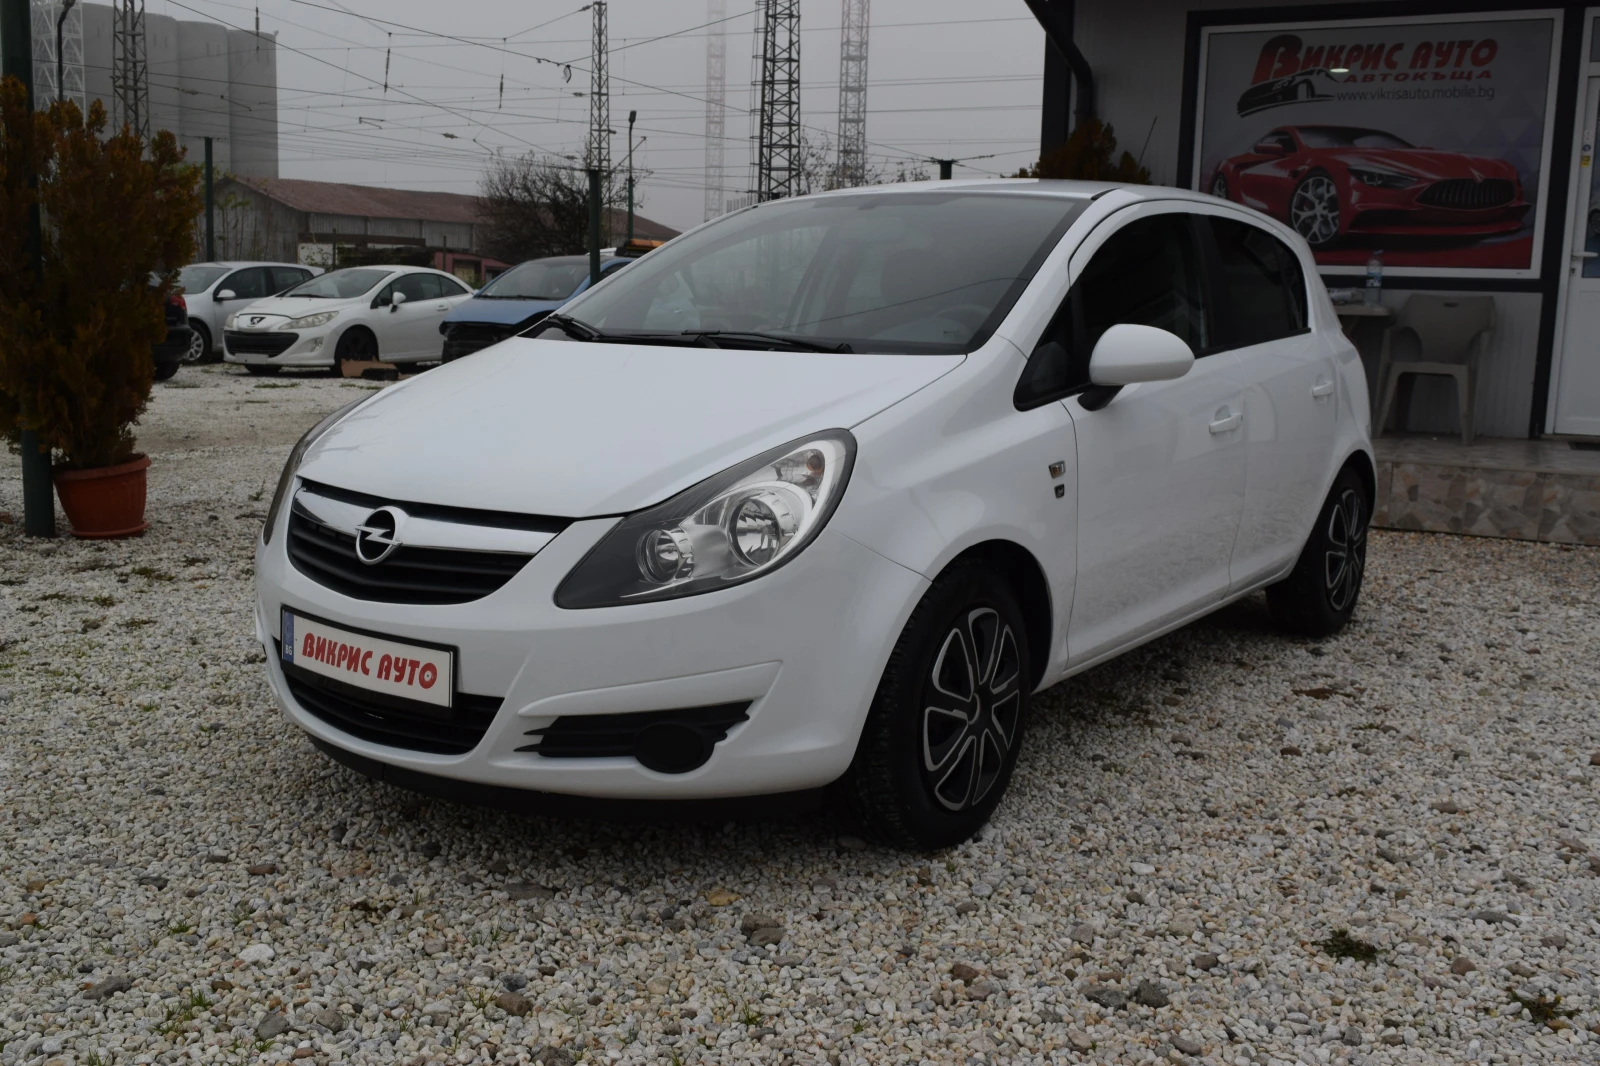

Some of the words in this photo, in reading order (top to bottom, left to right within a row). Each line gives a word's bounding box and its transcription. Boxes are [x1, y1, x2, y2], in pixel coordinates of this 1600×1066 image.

[1409, 39, 1498, 70] АУТО
[1342, 69, 1493, 84] АВТОКЪЩА
[1337, 85, 1495, 101] www.vikrisauto.mobile.bg
[285, 644, 293, 656] BG
[302, 632, 373, 676] ВИКРИС
[377, 653, 438, 690] АУТО
